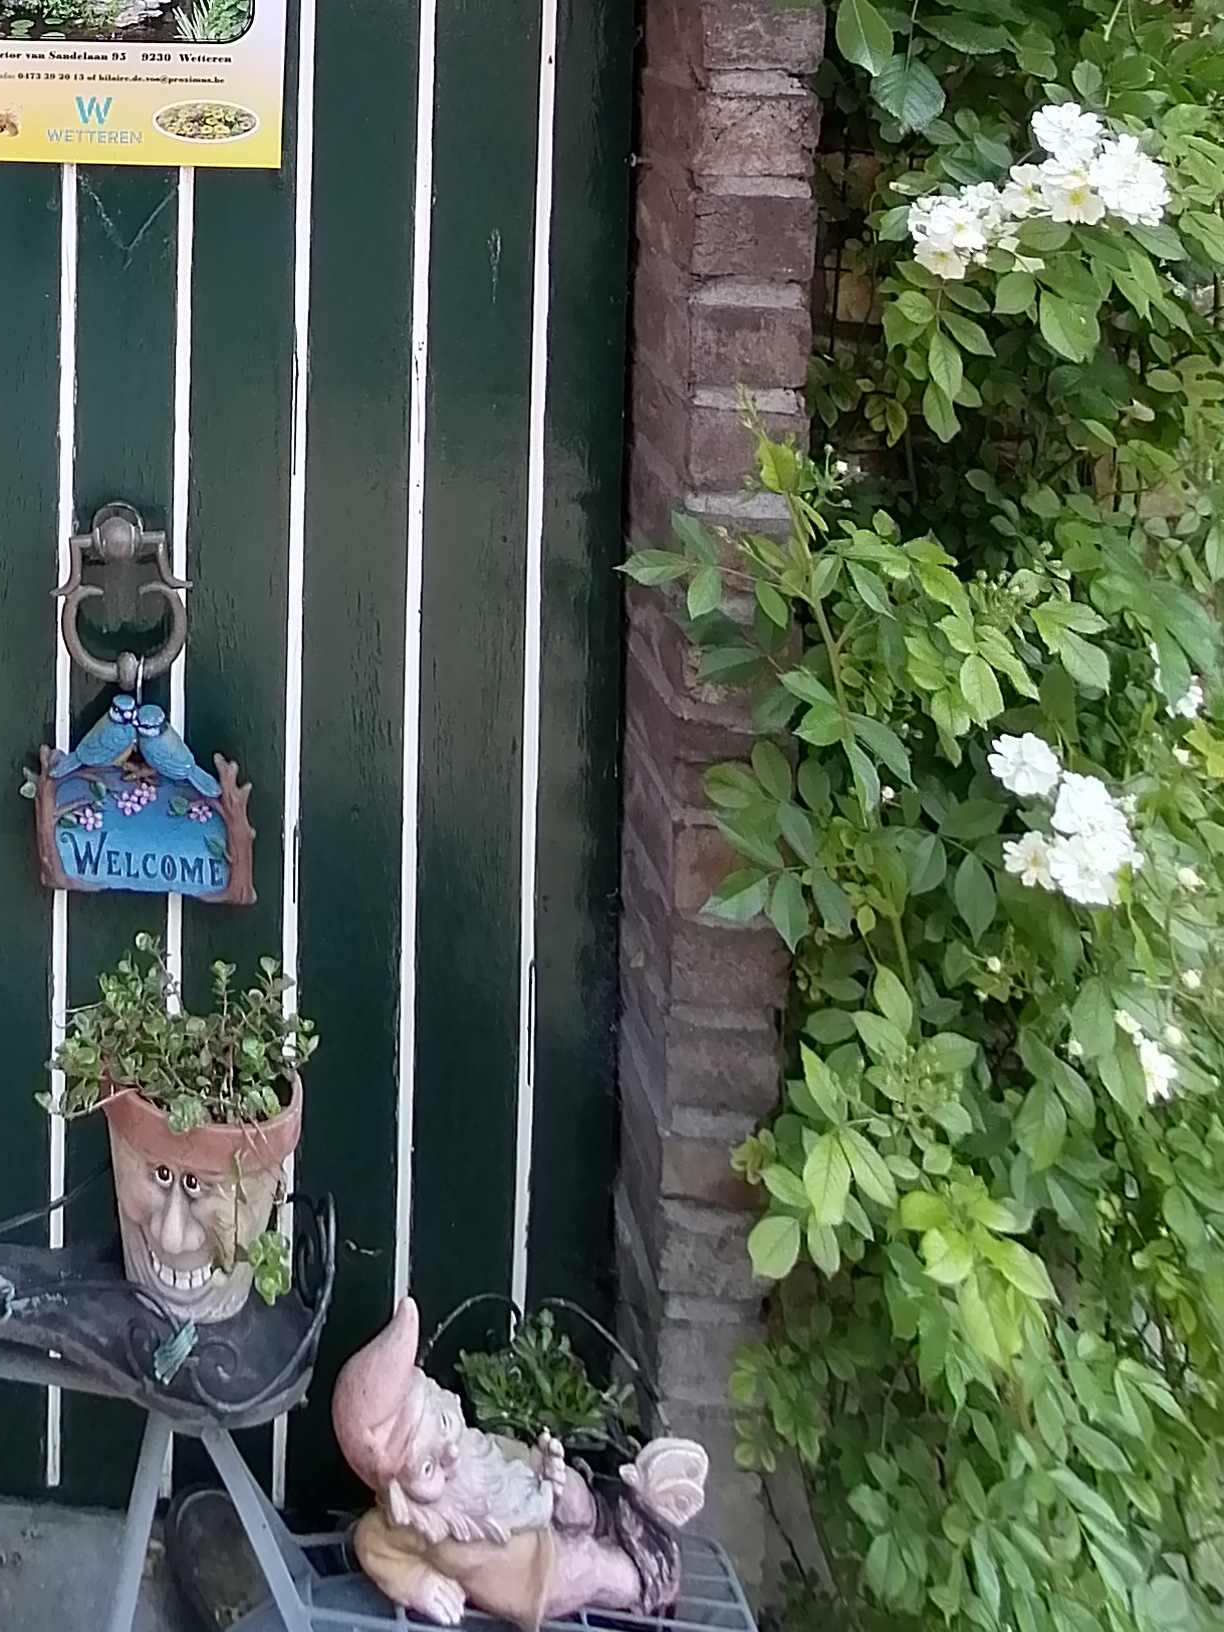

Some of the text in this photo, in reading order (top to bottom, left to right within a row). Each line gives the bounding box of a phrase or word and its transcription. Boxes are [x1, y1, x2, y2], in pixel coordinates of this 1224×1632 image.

[26, 51, 45, 59] van
[48, 51, 108, 60] Sandelaan
[141, 53, 171, 61] 9230
[179, 53, 232, 63] Wetteren
[18, 72, 41, 80] 0473
[76, 96, 113, 124] W
[47, 129, 142, 144] WETTEREN
[61, 831, 224, 886] WELCOME
